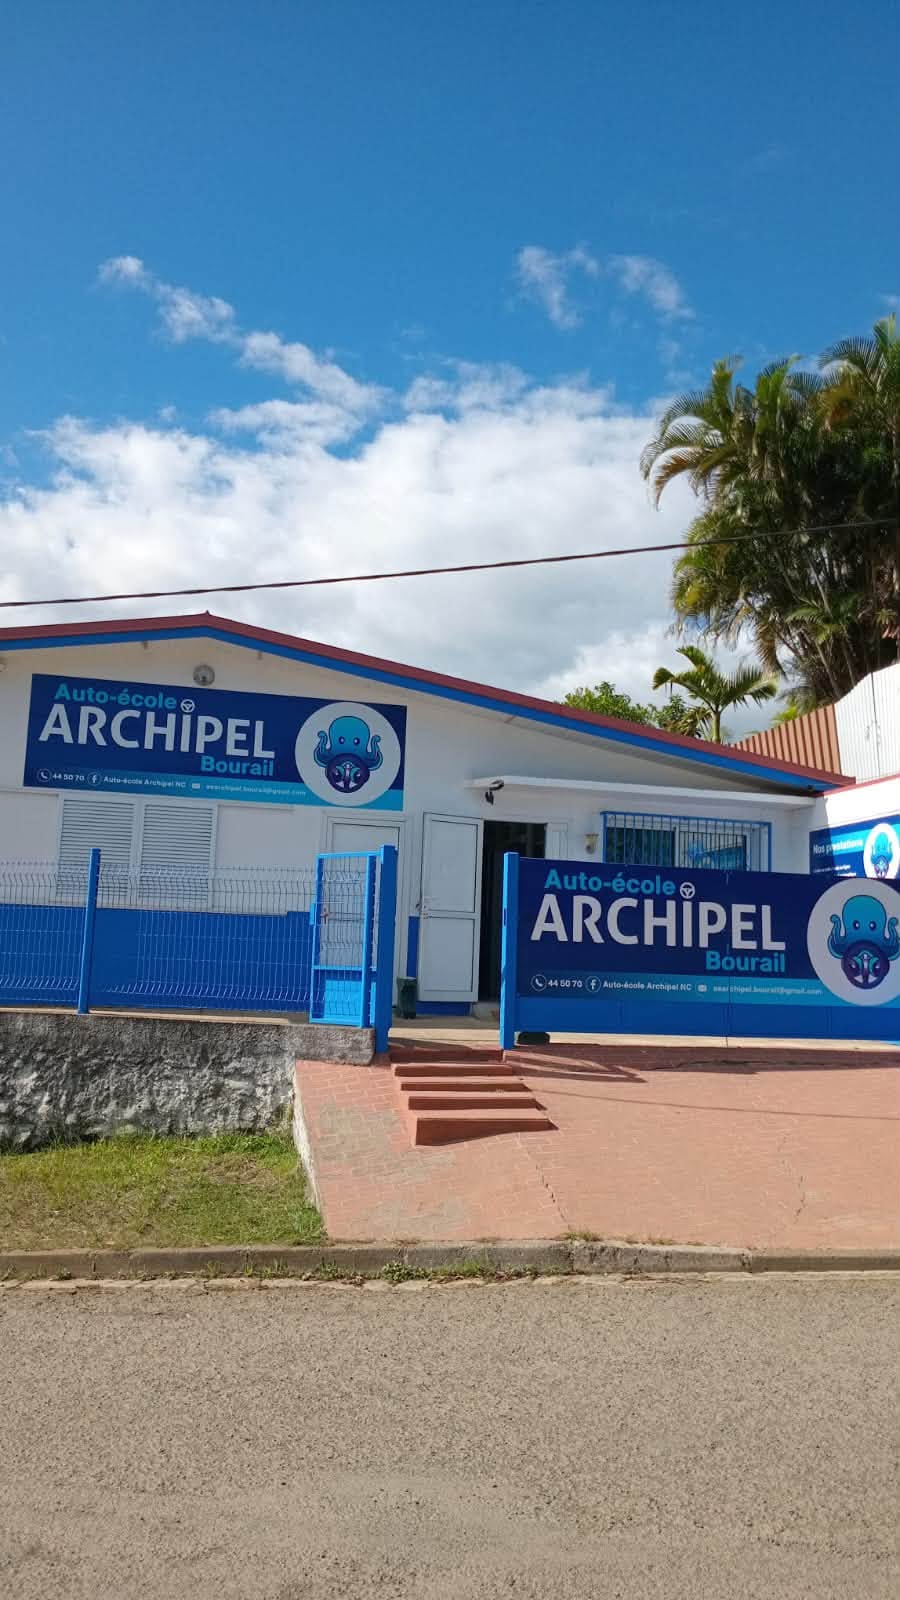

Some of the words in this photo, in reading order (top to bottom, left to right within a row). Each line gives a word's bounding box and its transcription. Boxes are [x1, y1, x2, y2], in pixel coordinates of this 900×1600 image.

[54, 683, 177, 710] Auto-école
[201, 755, 275, 777] Bourail
[103, 776, 142, 786] Auto-école
[175, 781, 187, 789] NC
[813, 844, 825, 855] Nos
[544, 869, 676, 895] Auto-école
[705, 950, 786, 973] Bourail
[548, 979, 559, 987] 44
[560, 980, 571, 988] 50
[572, 980, 583, 988] 70
[602, 979, 645, 990] Auto-école
[647, 981, 678, 993] Archipel
[679, 983, 692, 992] NC
